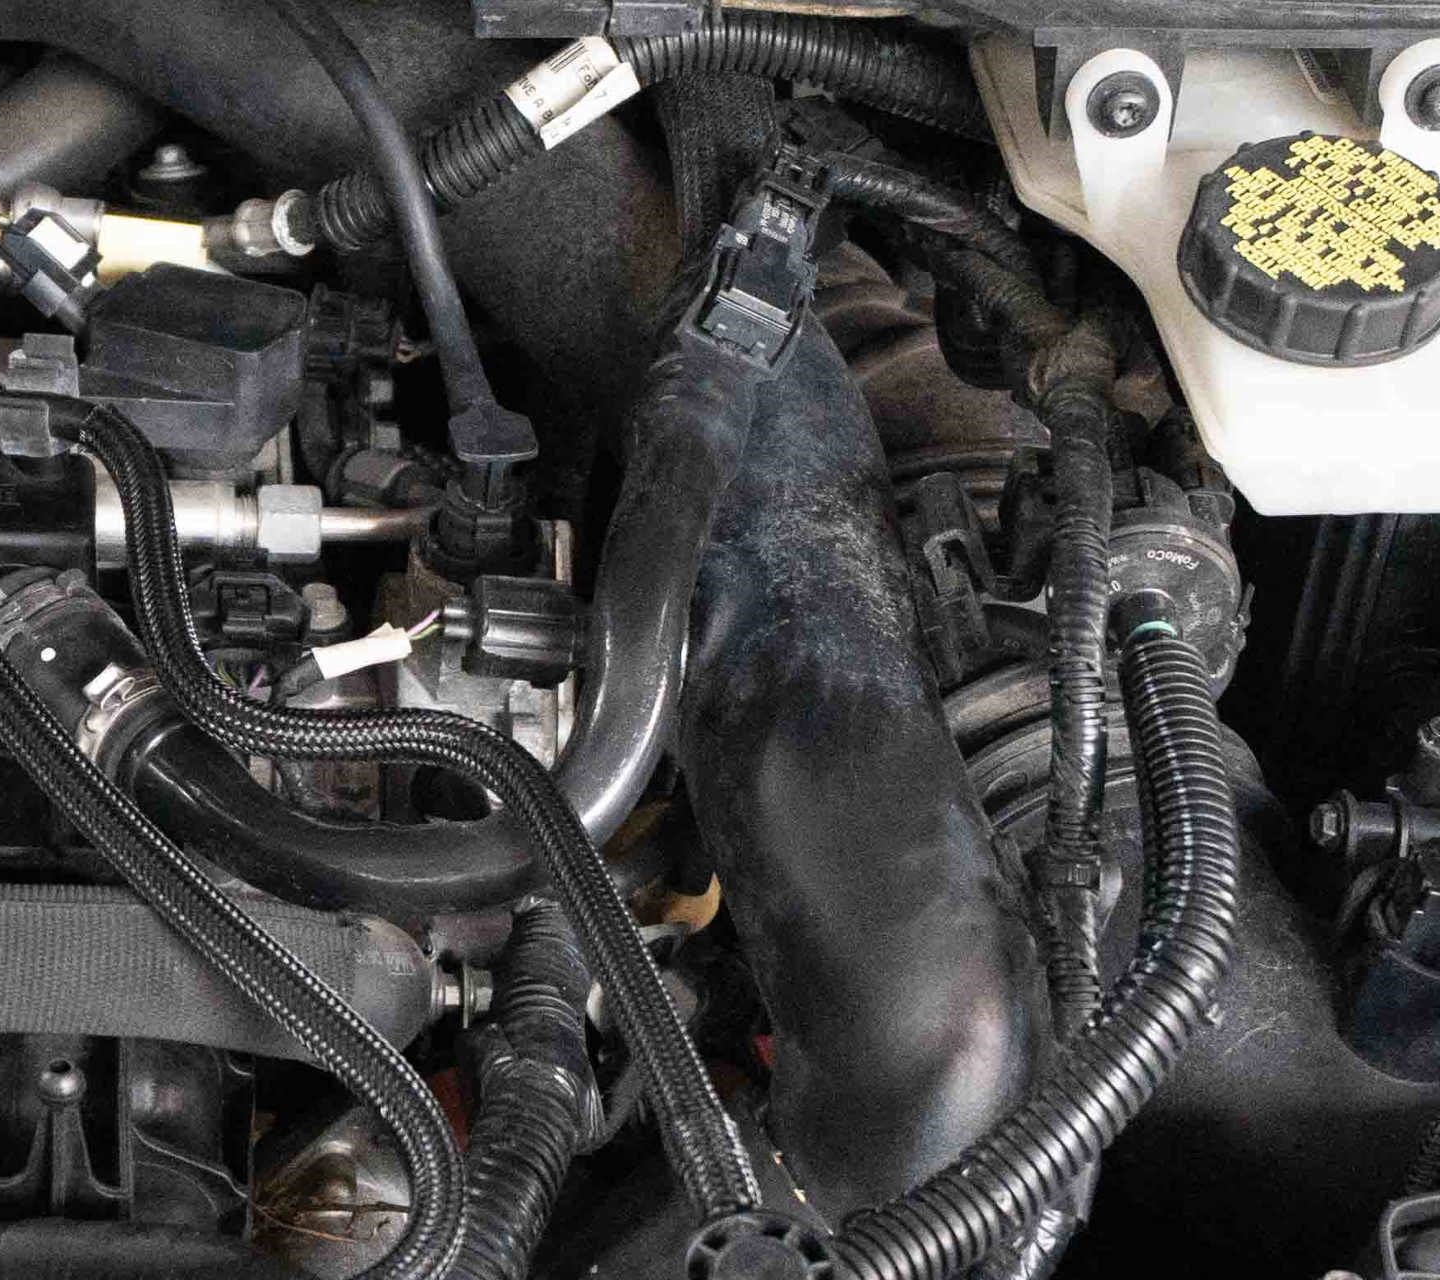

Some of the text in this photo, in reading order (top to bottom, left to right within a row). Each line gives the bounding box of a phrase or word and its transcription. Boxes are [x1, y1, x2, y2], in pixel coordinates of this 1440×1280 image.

[1283, 154, 1301, 169] A
[1299, 164, 1352, 202] SEALED
[1288, 139, 1327, 167] ONLY
[1324, 163, 1355, 186] DOT
[1352, 183, 1367, 196] 4
[1365, 191, 1408, 223] FLUID
[1305, 134, 1359, 172] BEFORE
[1333, 136, 1379, 168] CLEAN
[1376, 165, 1424, 200] FILLER
[1223, 164, 1270, 197] AVANT
[1264, 192, 1292, 212] DE
[1285, 206, 1310, 225] LE
[1251, 165, 1405, 273] NETTOYER LE BOUCHON
[1224, 181, 1380, 291] PLOYER QUE DU LIQUIDE
[1229, 202, 1348, 285] DOT 4 PROVENANT
[1146, 550, 1199, 570] FoMoCo
